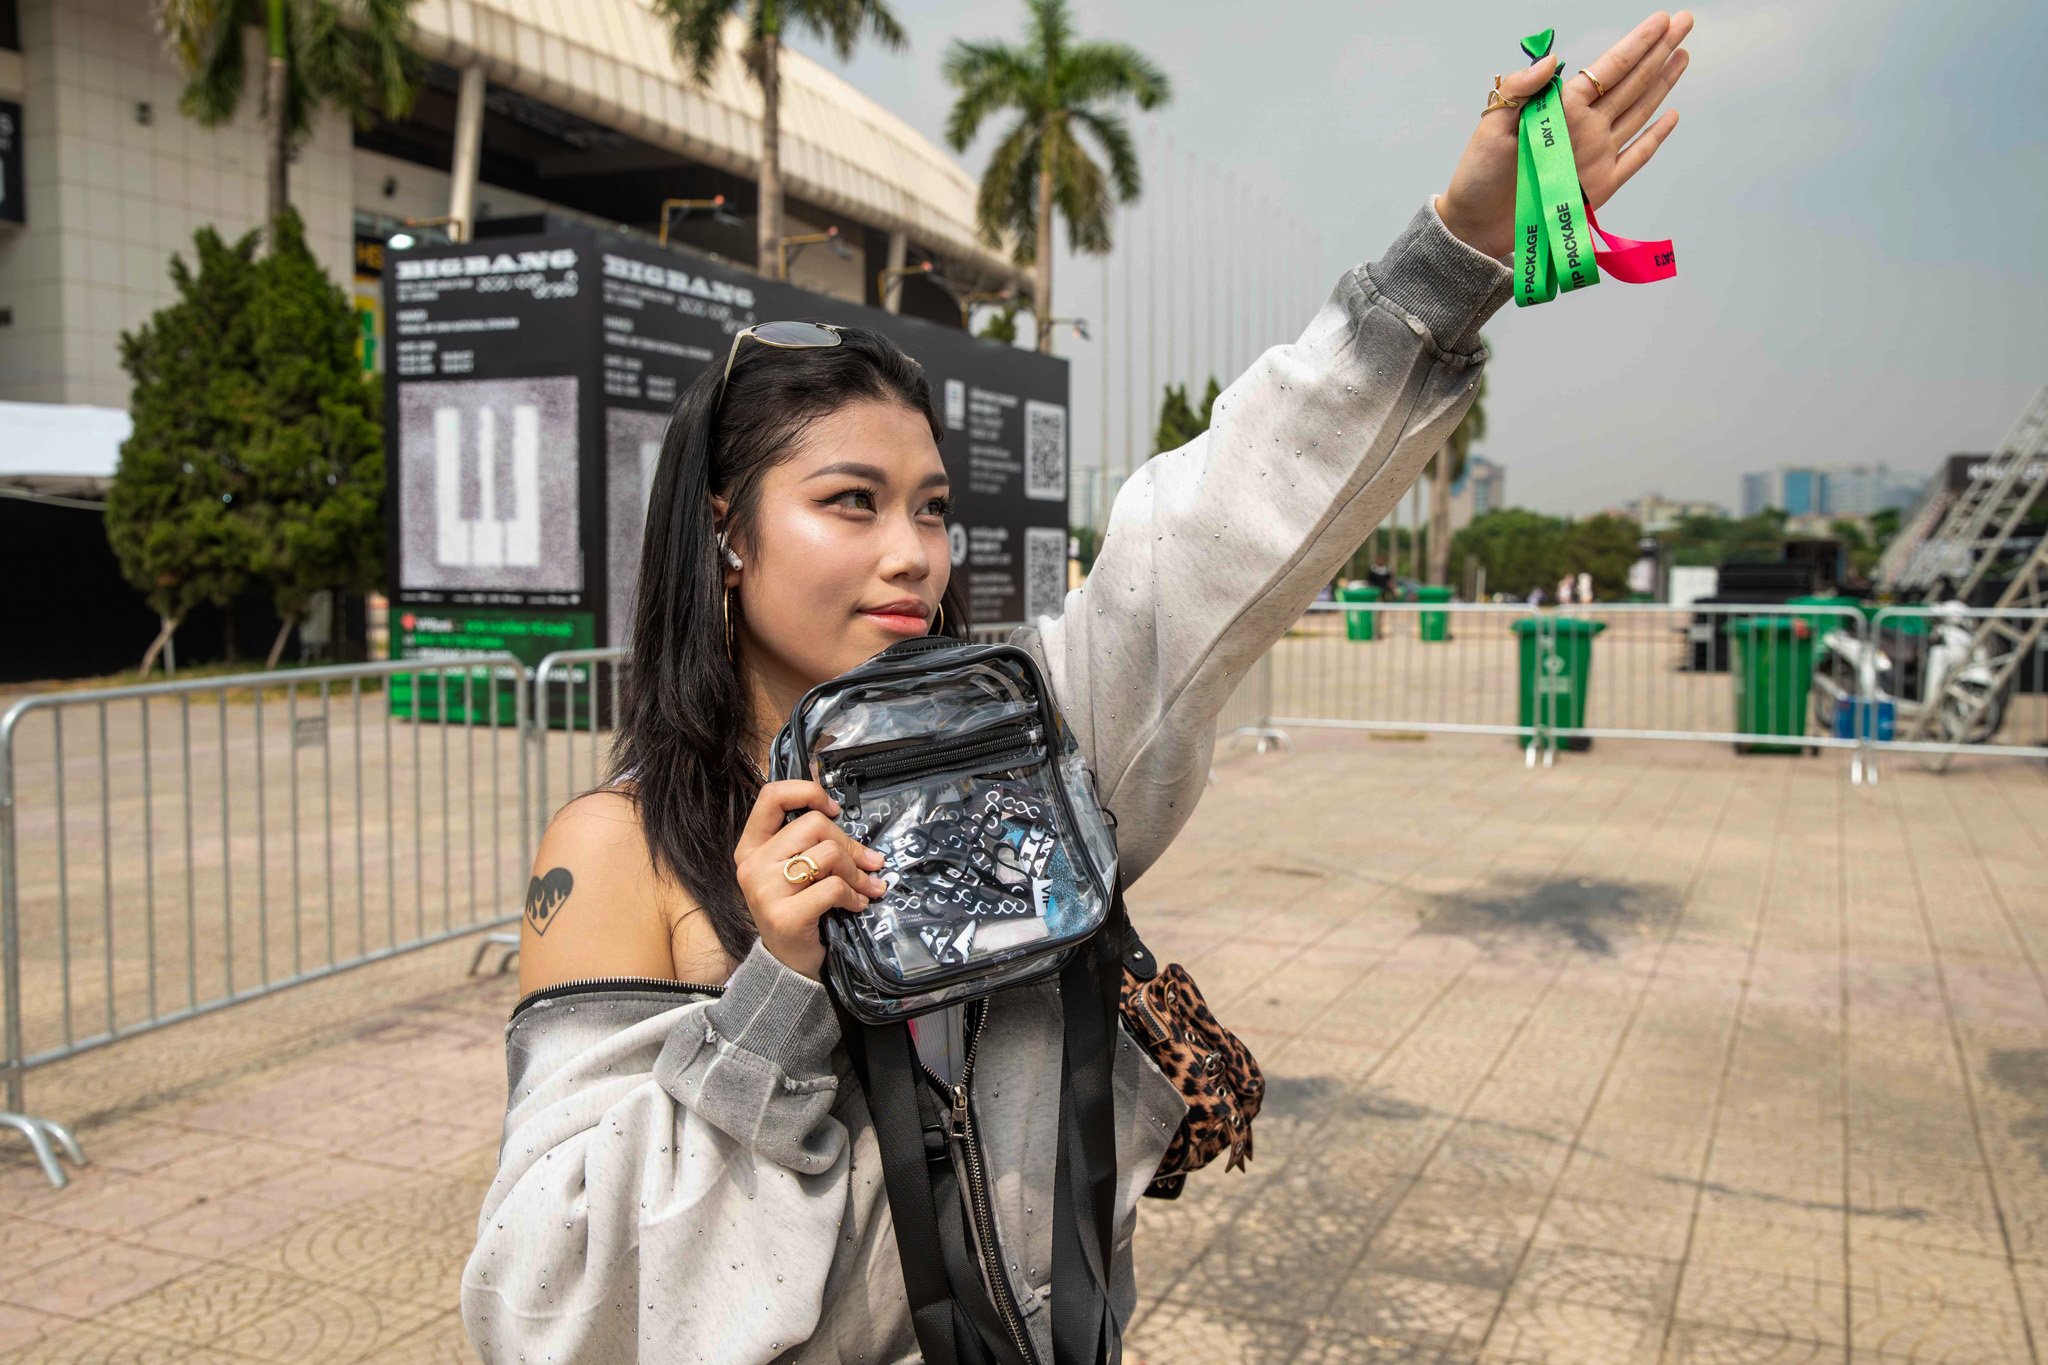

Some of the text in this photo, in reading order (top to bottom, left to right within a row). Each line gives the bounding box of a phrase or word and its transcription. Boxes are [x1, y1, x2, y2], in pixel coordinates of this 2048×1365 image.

[1540, 117, 1550, 126] 1
[1541, 127, 1555, 147] DAY
[1556, 202, 1581, 269] PACKAGE
[395, 248, 579, 281] BIGBANG
[602, 252, 757, 308] BIGBANG
[1524, 224, 1538, 294] PACKAGE
